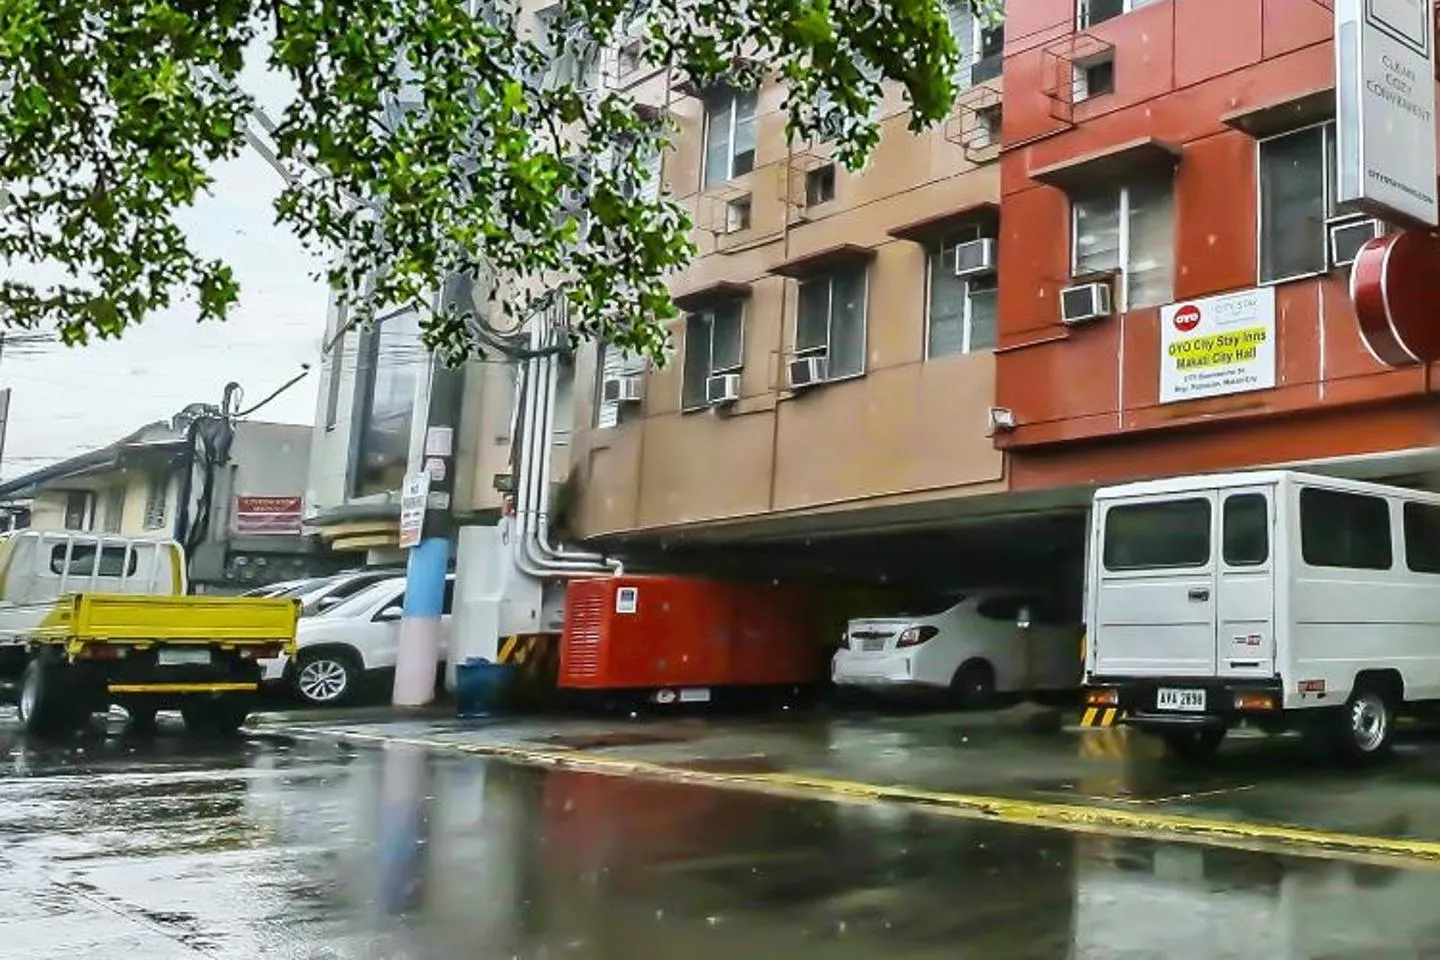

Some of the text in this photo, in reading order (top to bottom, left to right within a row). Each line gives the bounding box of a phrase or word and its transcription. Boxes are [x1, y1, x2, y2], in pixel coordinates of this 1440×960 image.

[1174, 312, 1200, 325] OYO
[1168, 330, 1267, 356] OYO City Stay Inns
[1175, 346, 1257, 370] Makati City Hall
